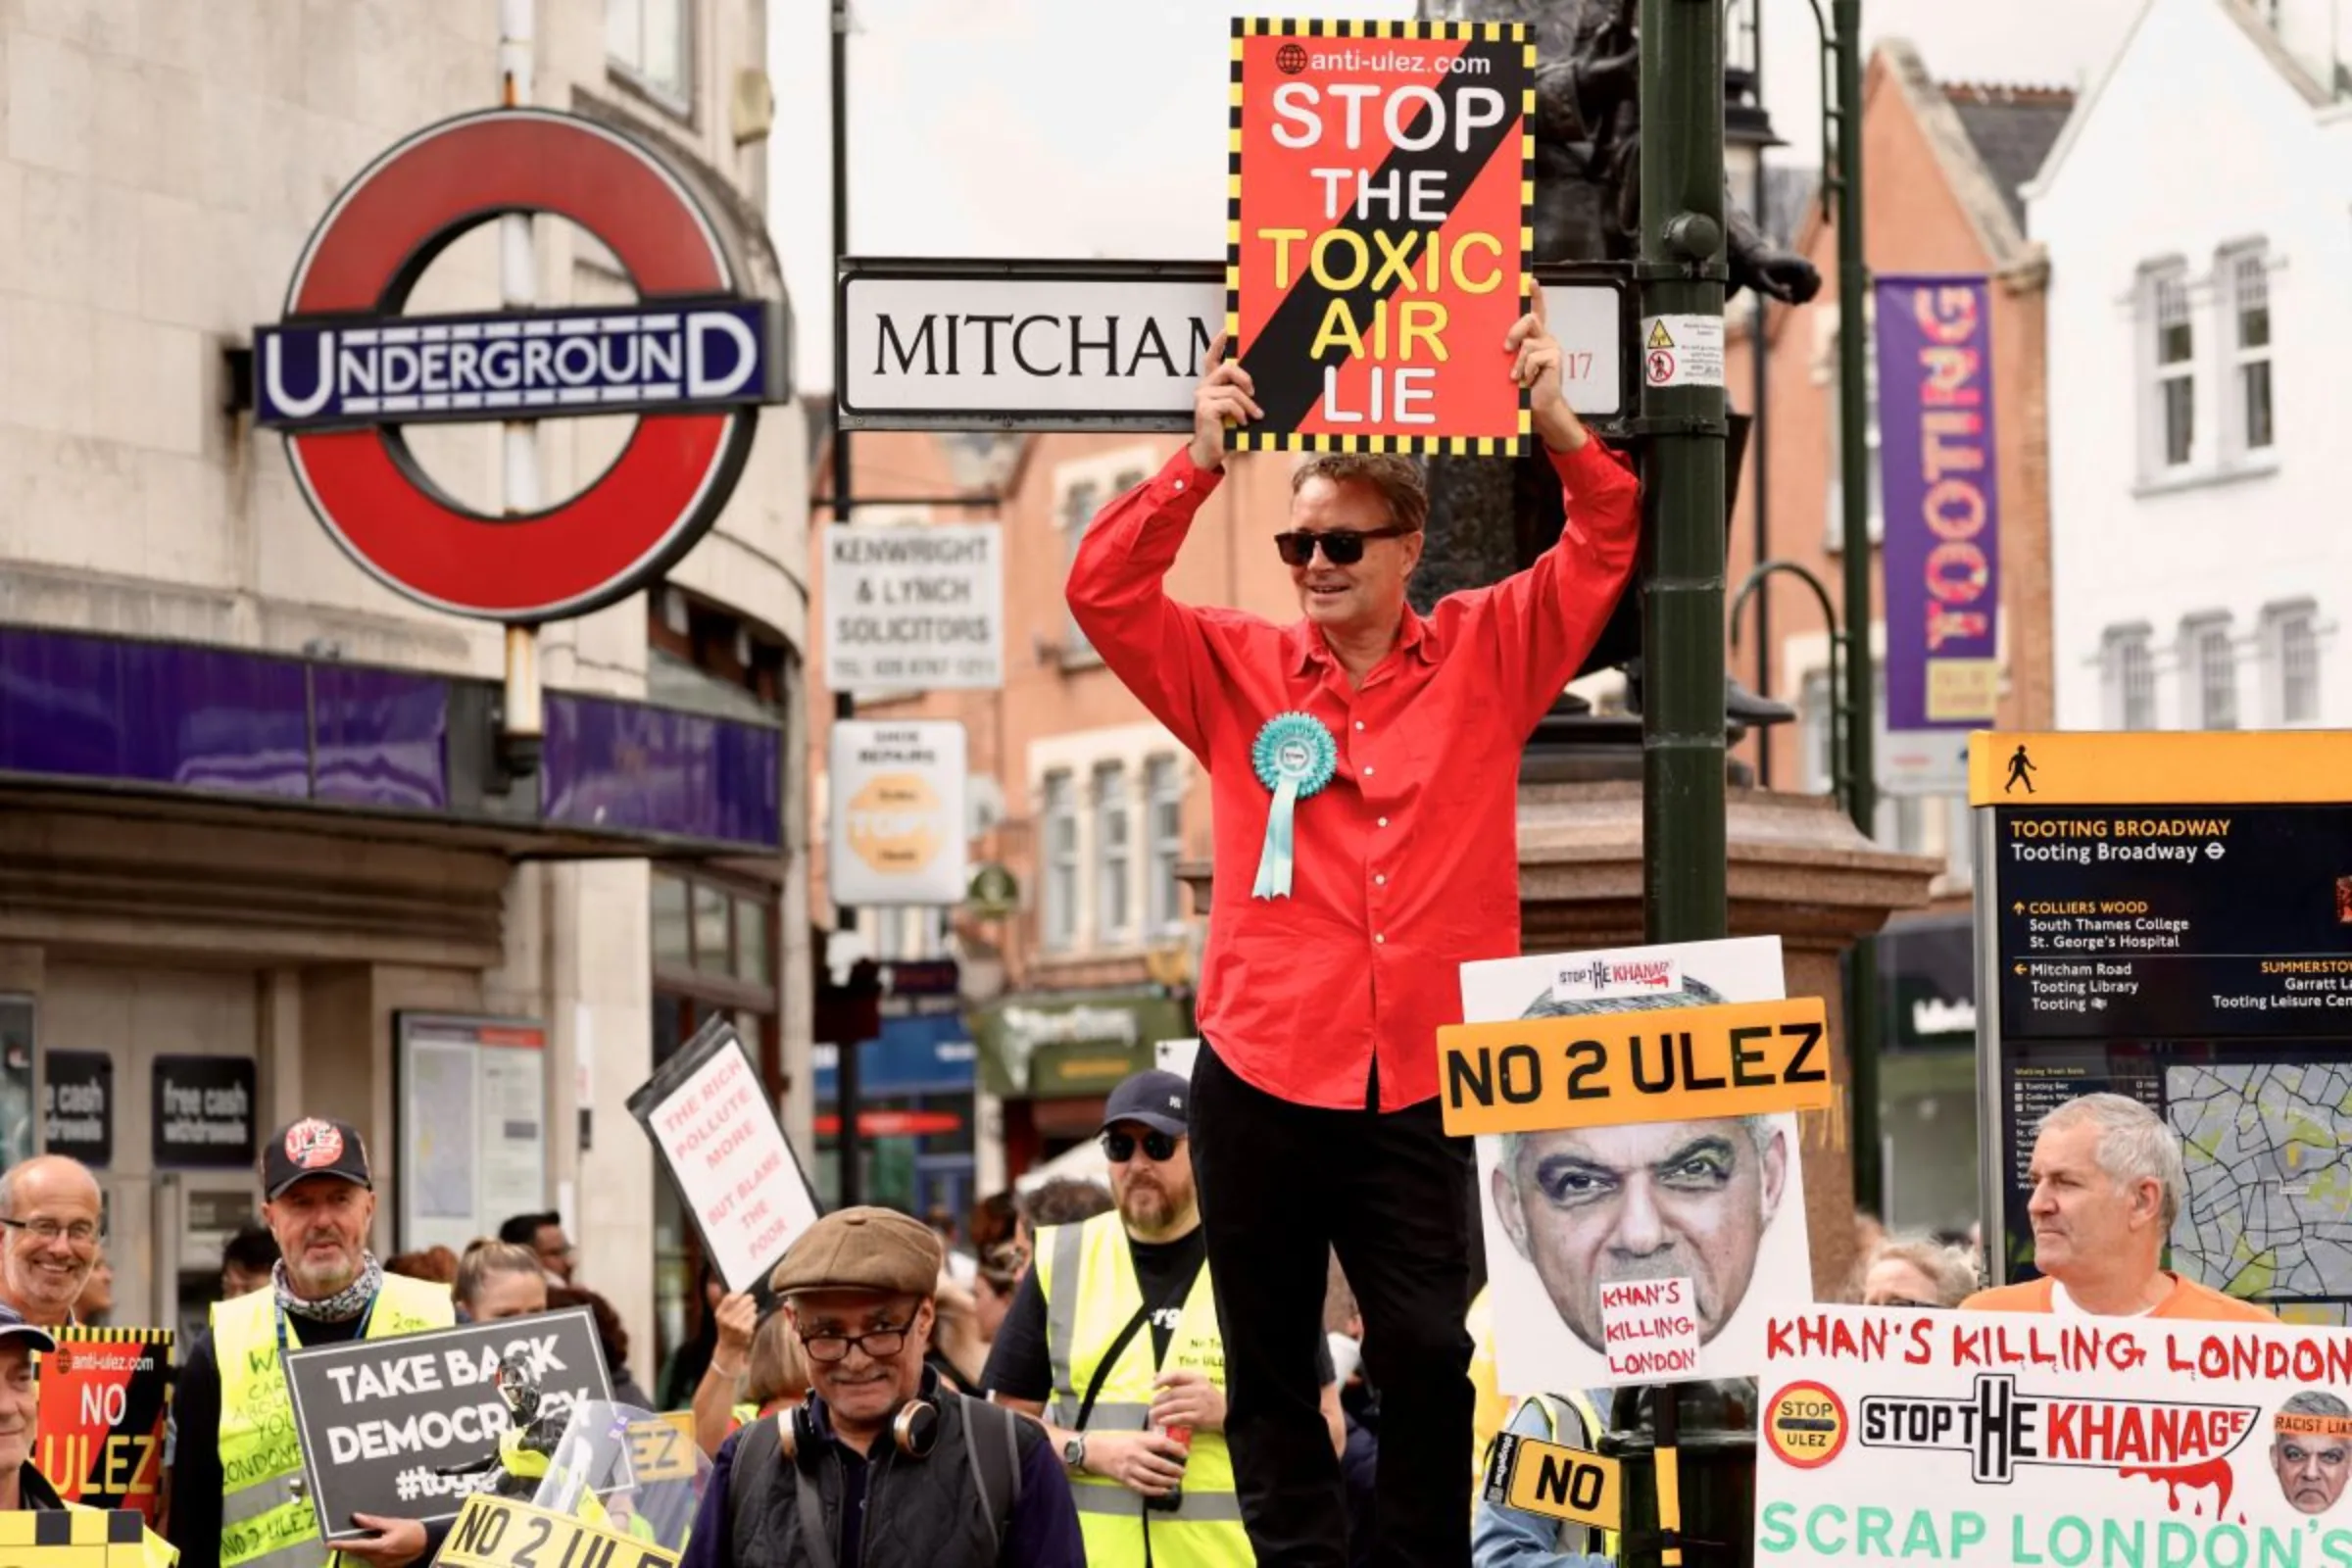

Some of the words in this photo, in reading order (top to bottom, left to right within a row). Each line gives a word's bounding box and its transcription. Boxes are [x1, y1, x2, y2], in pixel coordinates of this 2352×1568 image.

[1310, 50, 1492, 74] anti-ulez.com
[1271, 82, 1505, 153] STOP
[1311, 168, 1448, 221] THE
[1258, 228, 1503, 294] TOXIC
[1311, 299, 1449, 361] AIR
[266, 312, 757, 417] UNDERGROUND
[1324, 367, 1437, 423] LIE
[1914, 285, 1989, 651] TOOTING
[838, 616, 990, 647] SOLICITORS
[2011, 820, 2107, 837] TOOTING
[2114, 819, 2230, 836] BROADWAY
[2011, 844, 2091, 864] Tooting
[2097, 842, 2198, 863] Broadway
[2029, 902, 2096, 914] COLLIERS
[2100, 901, 2149, 913] WOOD
[2030, 918, 2072, 932] South
[2075, 917, 2132, 931] Thames
[2135, 917, 2190, 933] College
[2030, 936, 2049, 949] St.
[2053, 936, 2116, 952] George's
[2120, 935, 2180, 950] Hospital
[1559, 968, 1587, 983] STOP
[2030, 962, 2092, 976] Mitcham
[2097, 961, 2132, 976] Road
[2260, 961, 2352, 974] SUMMERSTO
[2284, 977, 2336, 991] Garratt
[2032, 980, 2086, 996] Tooting
[2089, 980, 2139, 995] Library
[2212, 995, 2267, 1010] Tooting
[2271, 995, 2322, 1007] Leisure
[2032, 998, 2087, 1012] Tooting
[1446, 1044, 1543, 1110] NO
[1565, 1040, 1611, 1101] 2
[1630, 1022, 1828, 1096] ULEZ
[662, 1095, 701, 1135] THE
[700, 1058, 744, 1103] RICH
[674, 1086, 753, 1161] POLLUTE
[704, 1119, 758, 1170] MORE
[706, 1192, 738, 1227] BUT
[1602, 1281, 1681, 1309] KHAN'S
[1606, 1316, 1694, 1343] KILLING
[72, 1351, 154, 1372] anti-ulez.com
[1608, 1348, 1695, 1374] LONDON
[1767, 1314, 1934, 1364] KHAN'S
[1953, 1326, 2148, 1373] KILLING
[2167, 1334, 2352, 1386] LONDON
[327, 1353, 443, 1404] TAKE
[80, 1383, 127, 1426] NO
[1781, 1400, 1834, 1417] STOP
[327, 1388, 589, 1465] DEMOCRCY
[1787, 1433, 1828, 1448] ULEZ
[1866, 1402, 1952, 1443] STOP
[1958, 1380, 2037, 1476] THE
[2048, 1403, 2250, 1463] KHANAGE
[2275, 1416, 2323, 1433] RACIST
[44, 1434, 156, 1495] ULEZ
[1535, 1453, 1605, 1512] NO
[453, 1503, 511, 1556] NO
[511, 1519, 553, 1568] 2
[1759, 1500, 1986, 1560] SCRAP
[2011, 1512, 2352, 1568] LONDON'S
